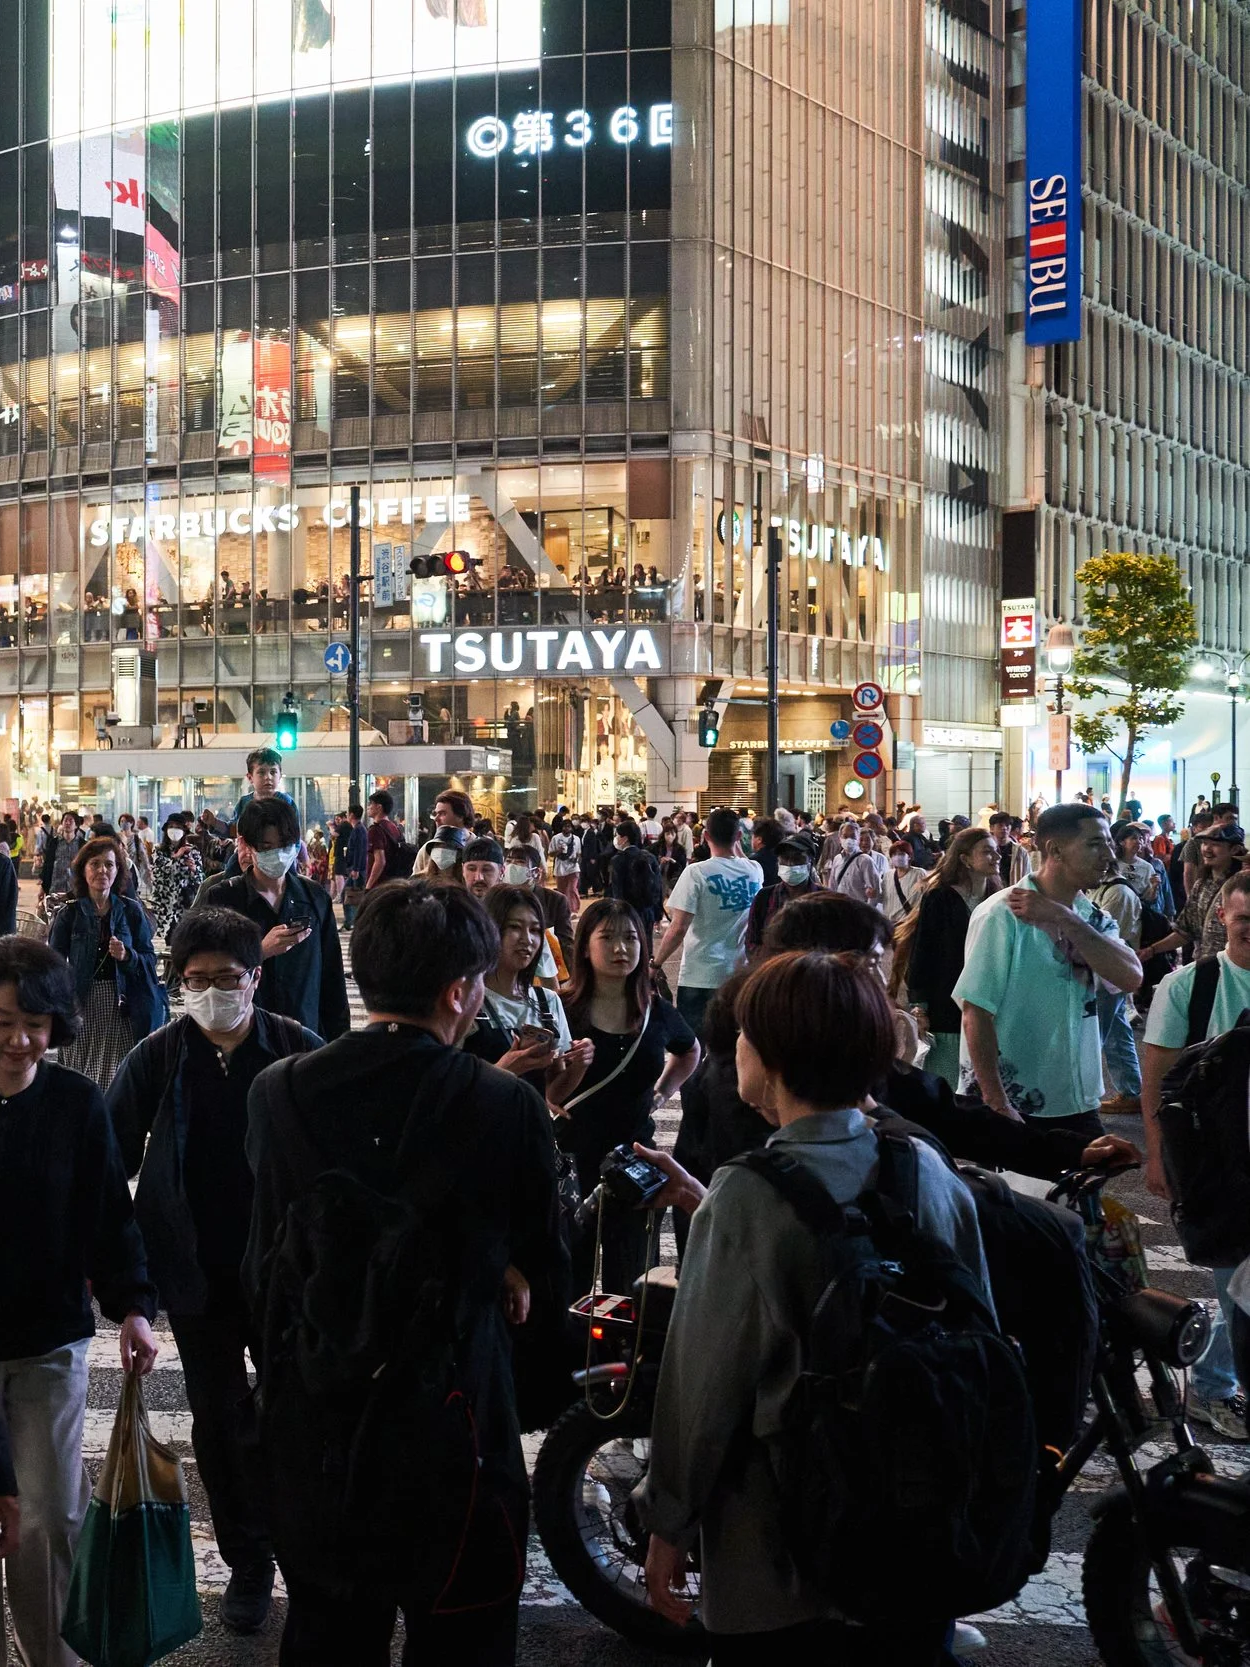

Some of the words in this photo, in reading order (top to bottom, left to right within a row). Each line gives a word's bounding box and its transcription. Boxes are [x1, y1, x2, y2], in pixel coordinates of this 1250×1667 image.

[1029, 174, 1067, 318] SEIBU
[91, 502, 300, 547] STARBUCKS
[323, 494, 472, 528] COFFEE
[381, 548, 390, 601] 渋谷駅前
[1003, 603, 1035, 611] TSUTAYA
[1006, 617, 1032, 641] 本
[420, 630, 662, 673] TSUTAYA
[1006, 665, 1032, 673] WIRED
[729, 739, 795, 749] STARBUKS
[795, 739, 830, 748] COFFE
